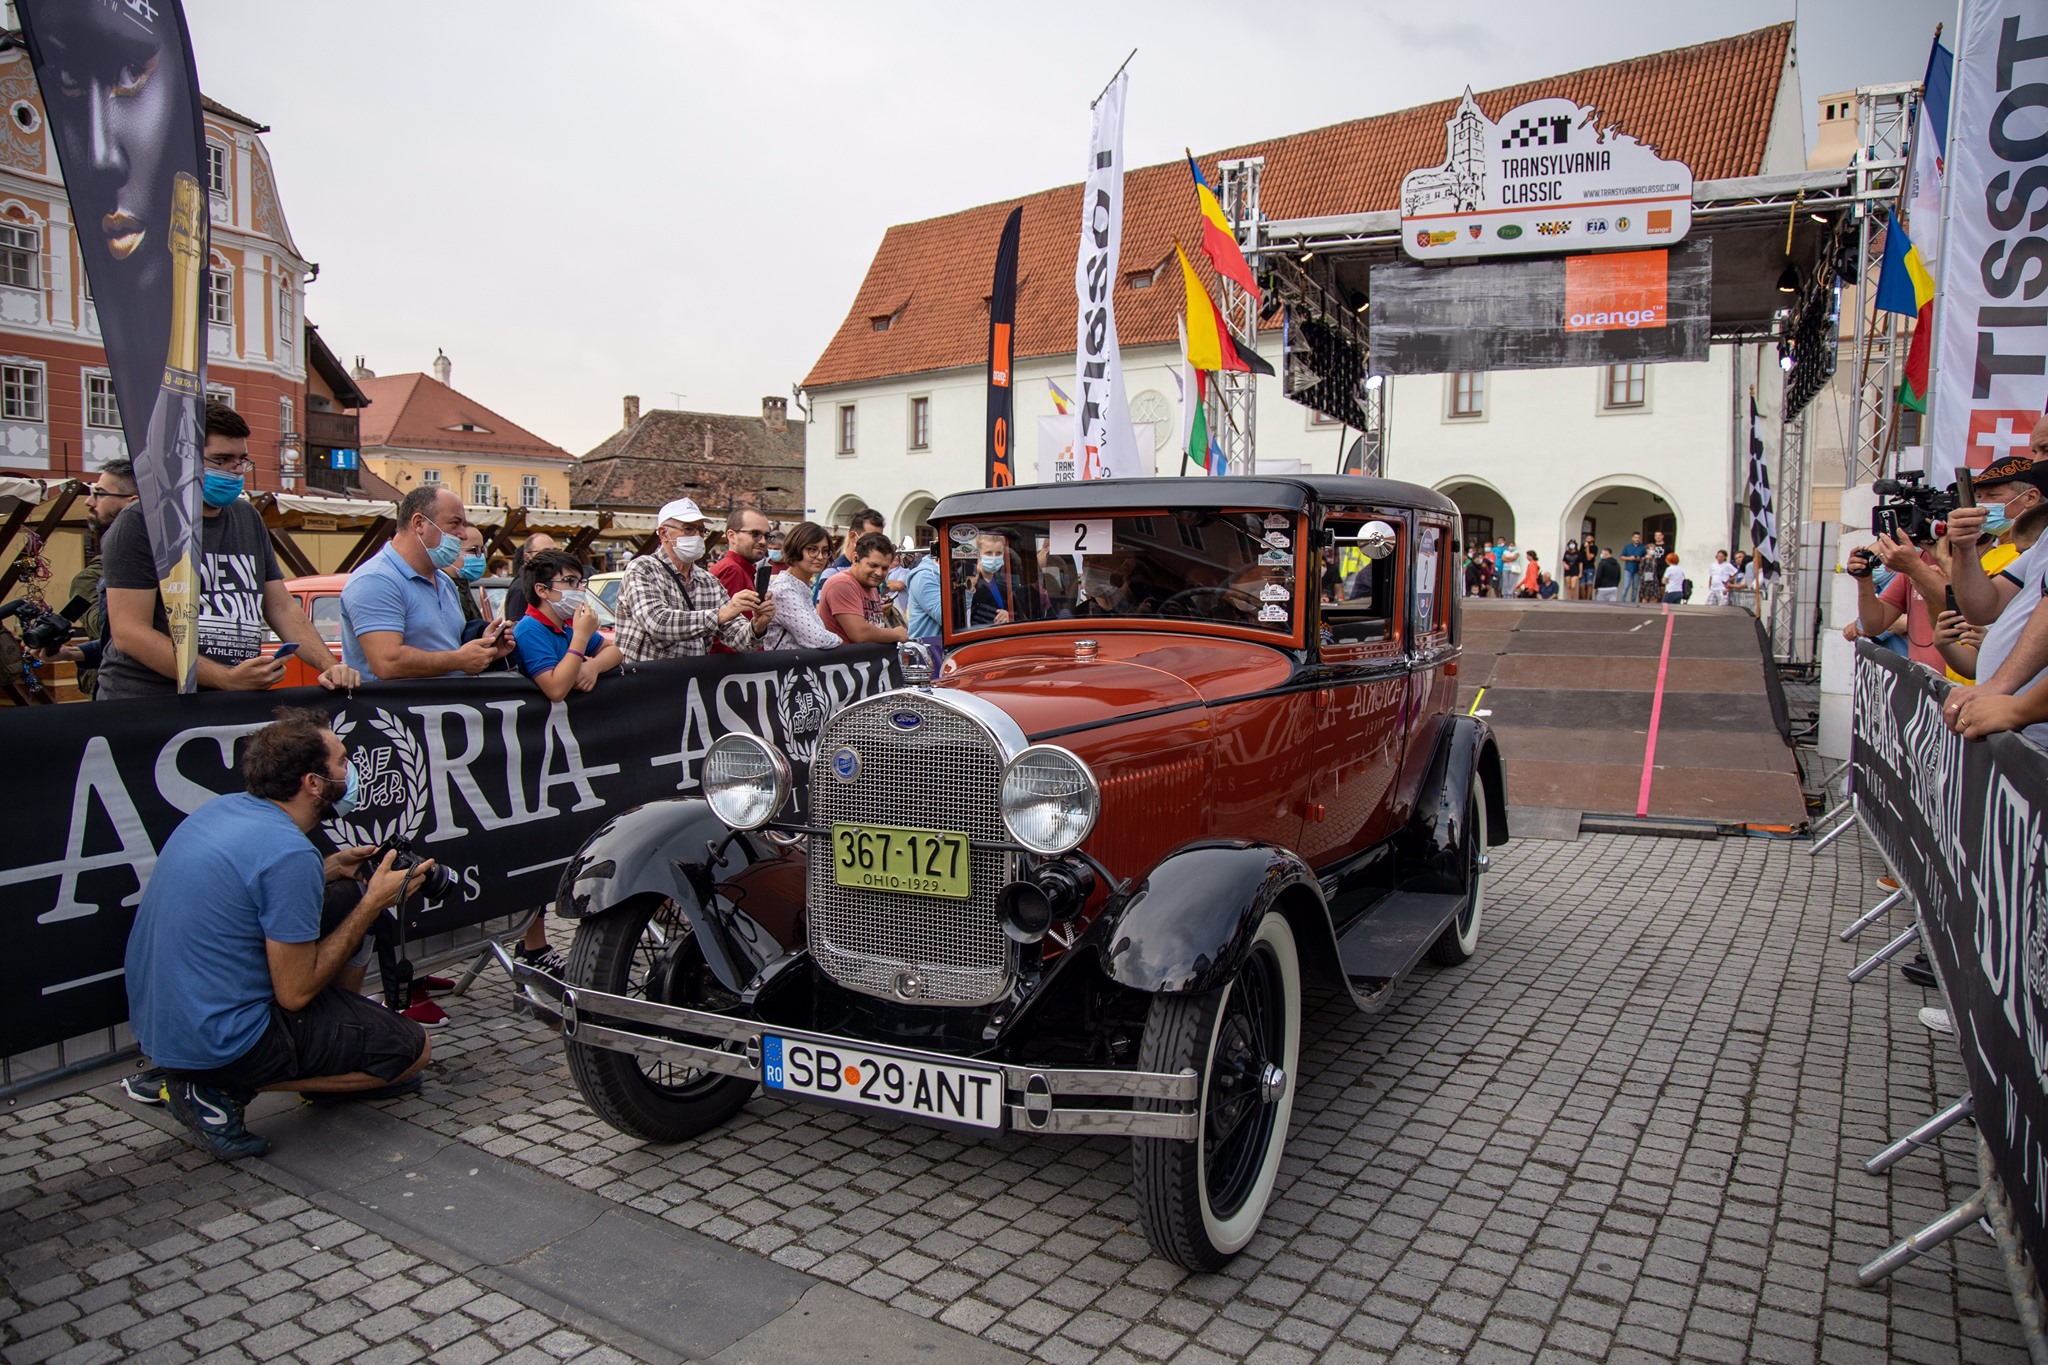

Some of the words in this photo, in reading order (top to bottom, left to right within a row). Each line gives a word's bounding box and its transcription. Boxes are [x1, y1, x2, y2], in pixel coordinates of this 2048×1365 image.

[1502, 150, 1611, 179] TRANSYLVANIA
[1502, 181, 1562, 205] CLASSIC
[1582, 183, 1680, 198] WWW.TRANSYLVANIACLASSIC.COM
[1647, 226, 1670, 234] orange
[1569, 309, 1655, 327] orange
[1074, 523, 1088, 551] 2
[200, 552, 258, 592] NEW
[1423, 559, 1429, 590] 2
[205, 647, 245, 658] ATHLETIC
[897, 712, 918, 724] Ford
[840, 830, 961, 879] 367-127
[767, 1065, 782, 1083] RO
[788, 1046, 842, 1092] SB
[858, 1058, 904, 1104] 29
[912, 1068, 992, 1120] ANT
